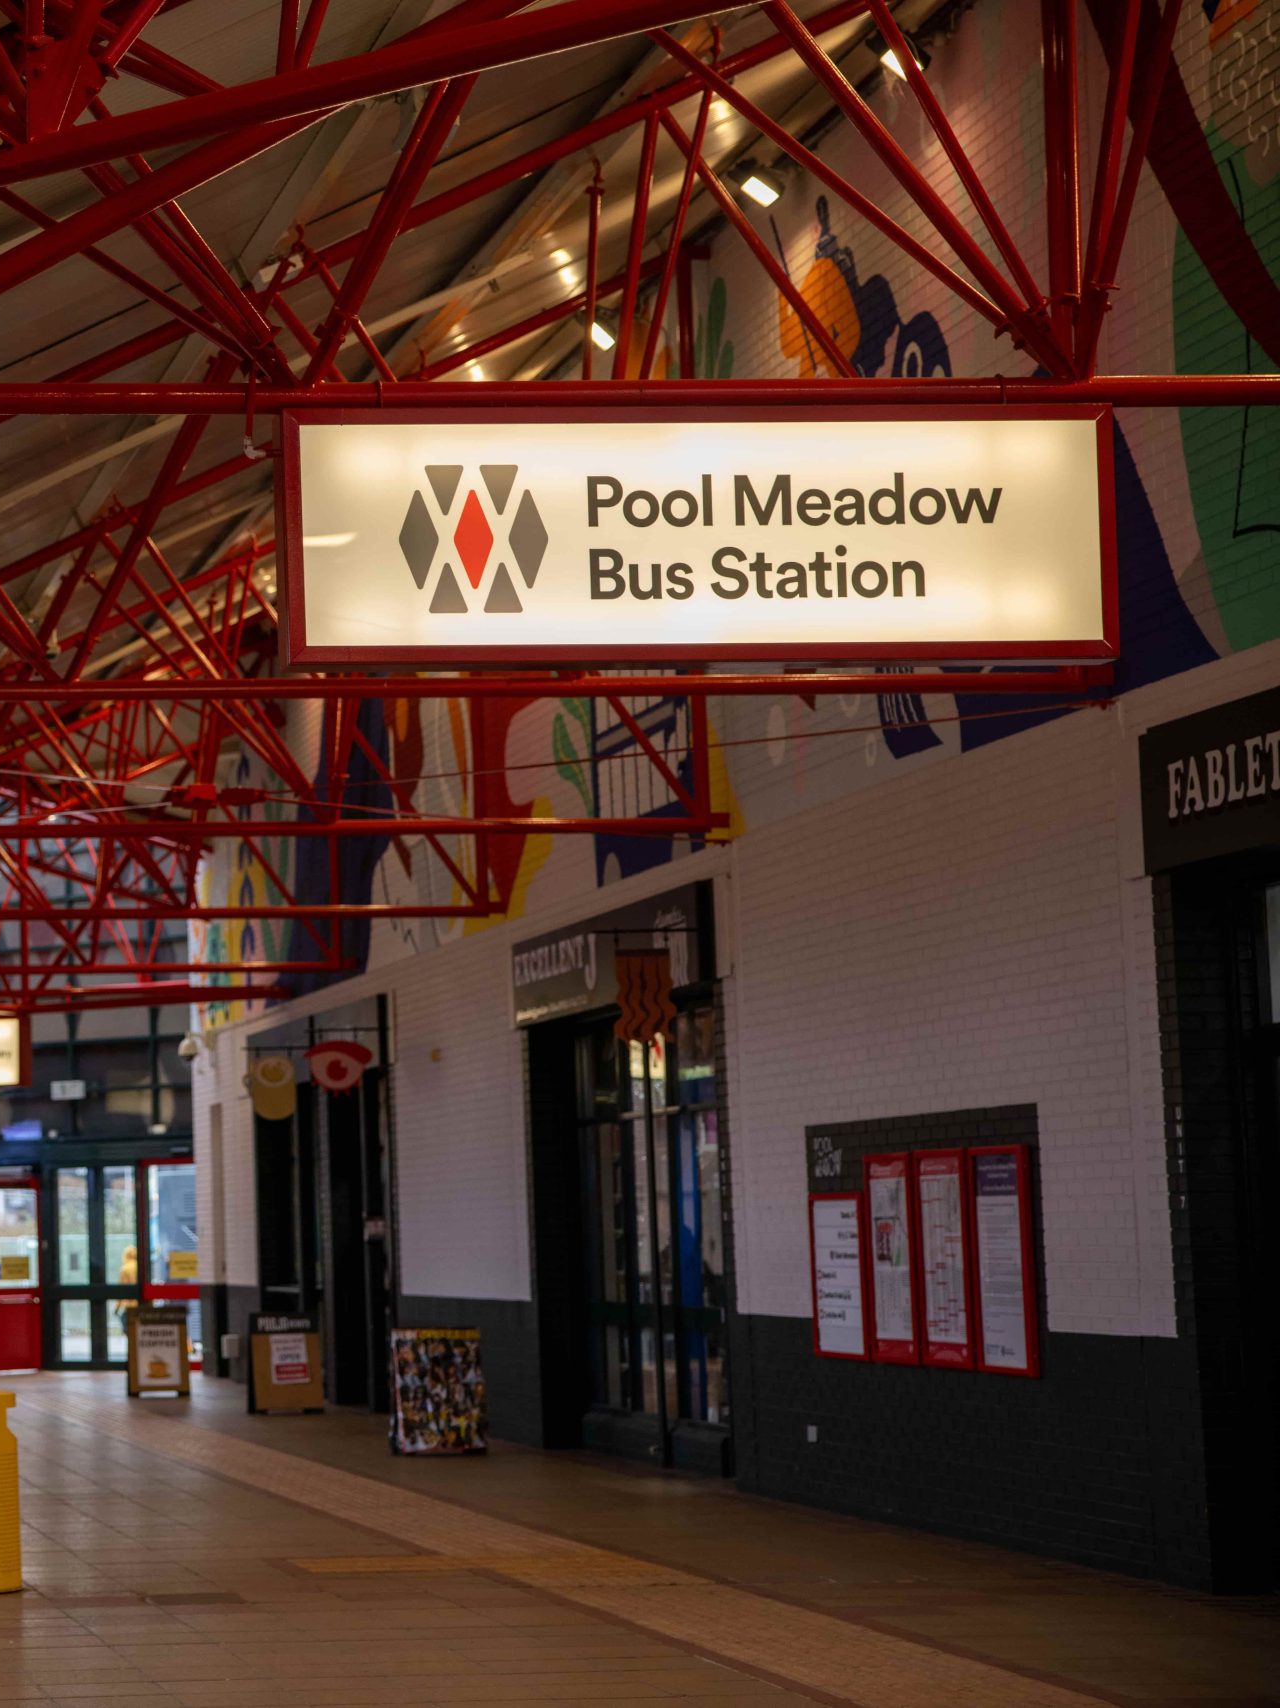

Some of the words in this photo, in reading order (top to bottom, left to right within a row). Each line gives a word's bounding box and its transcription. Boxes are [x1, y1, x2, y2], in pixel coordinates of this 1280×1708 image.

[586, 473, 714, 528] Pool
[733, 472, 1004, 527] Meadow
[588, 548, 699, 601] Bus
[710, 544, 926, 600] Station
[514, 934, 585, 987] EXCELLENT
[584, 932, 596, 990] J
[1175, 1105, 1185, 1174] UNIT
